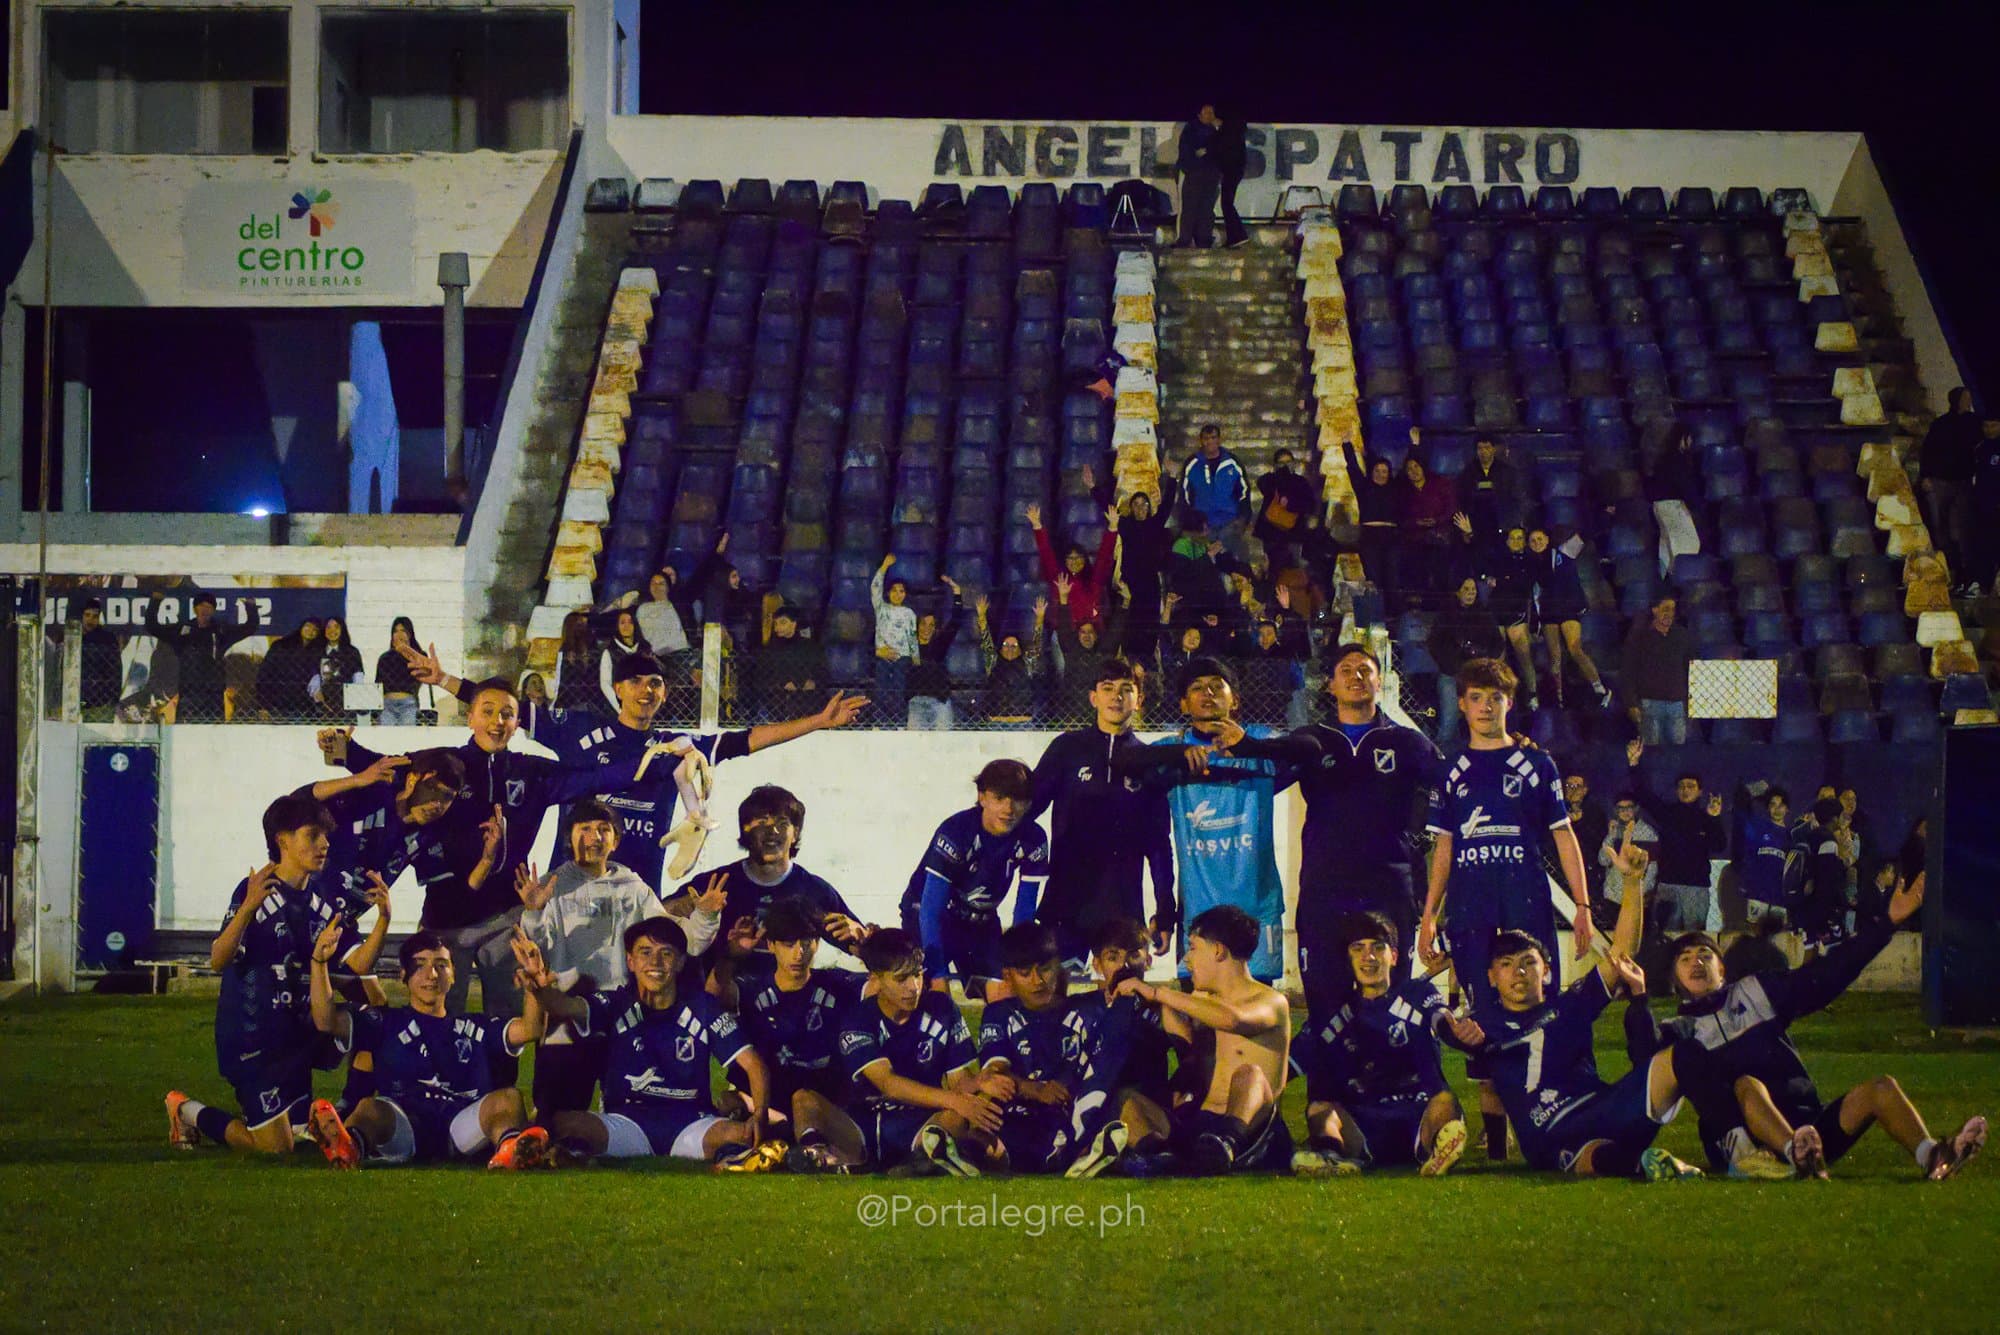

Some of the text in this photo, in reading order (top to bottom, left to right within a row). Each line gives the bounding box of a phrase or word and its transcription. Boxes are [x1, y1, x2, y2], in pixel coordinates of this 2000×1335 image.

[934, 125, 1580, 184] ANGEL SPATARO
[240, 213, 280, 240] del
[238, 241, 364, 271] centro
[240, 276, 362, 287] PINTURERIAS
[1456, 844, 1525, 863] JOSVIC
